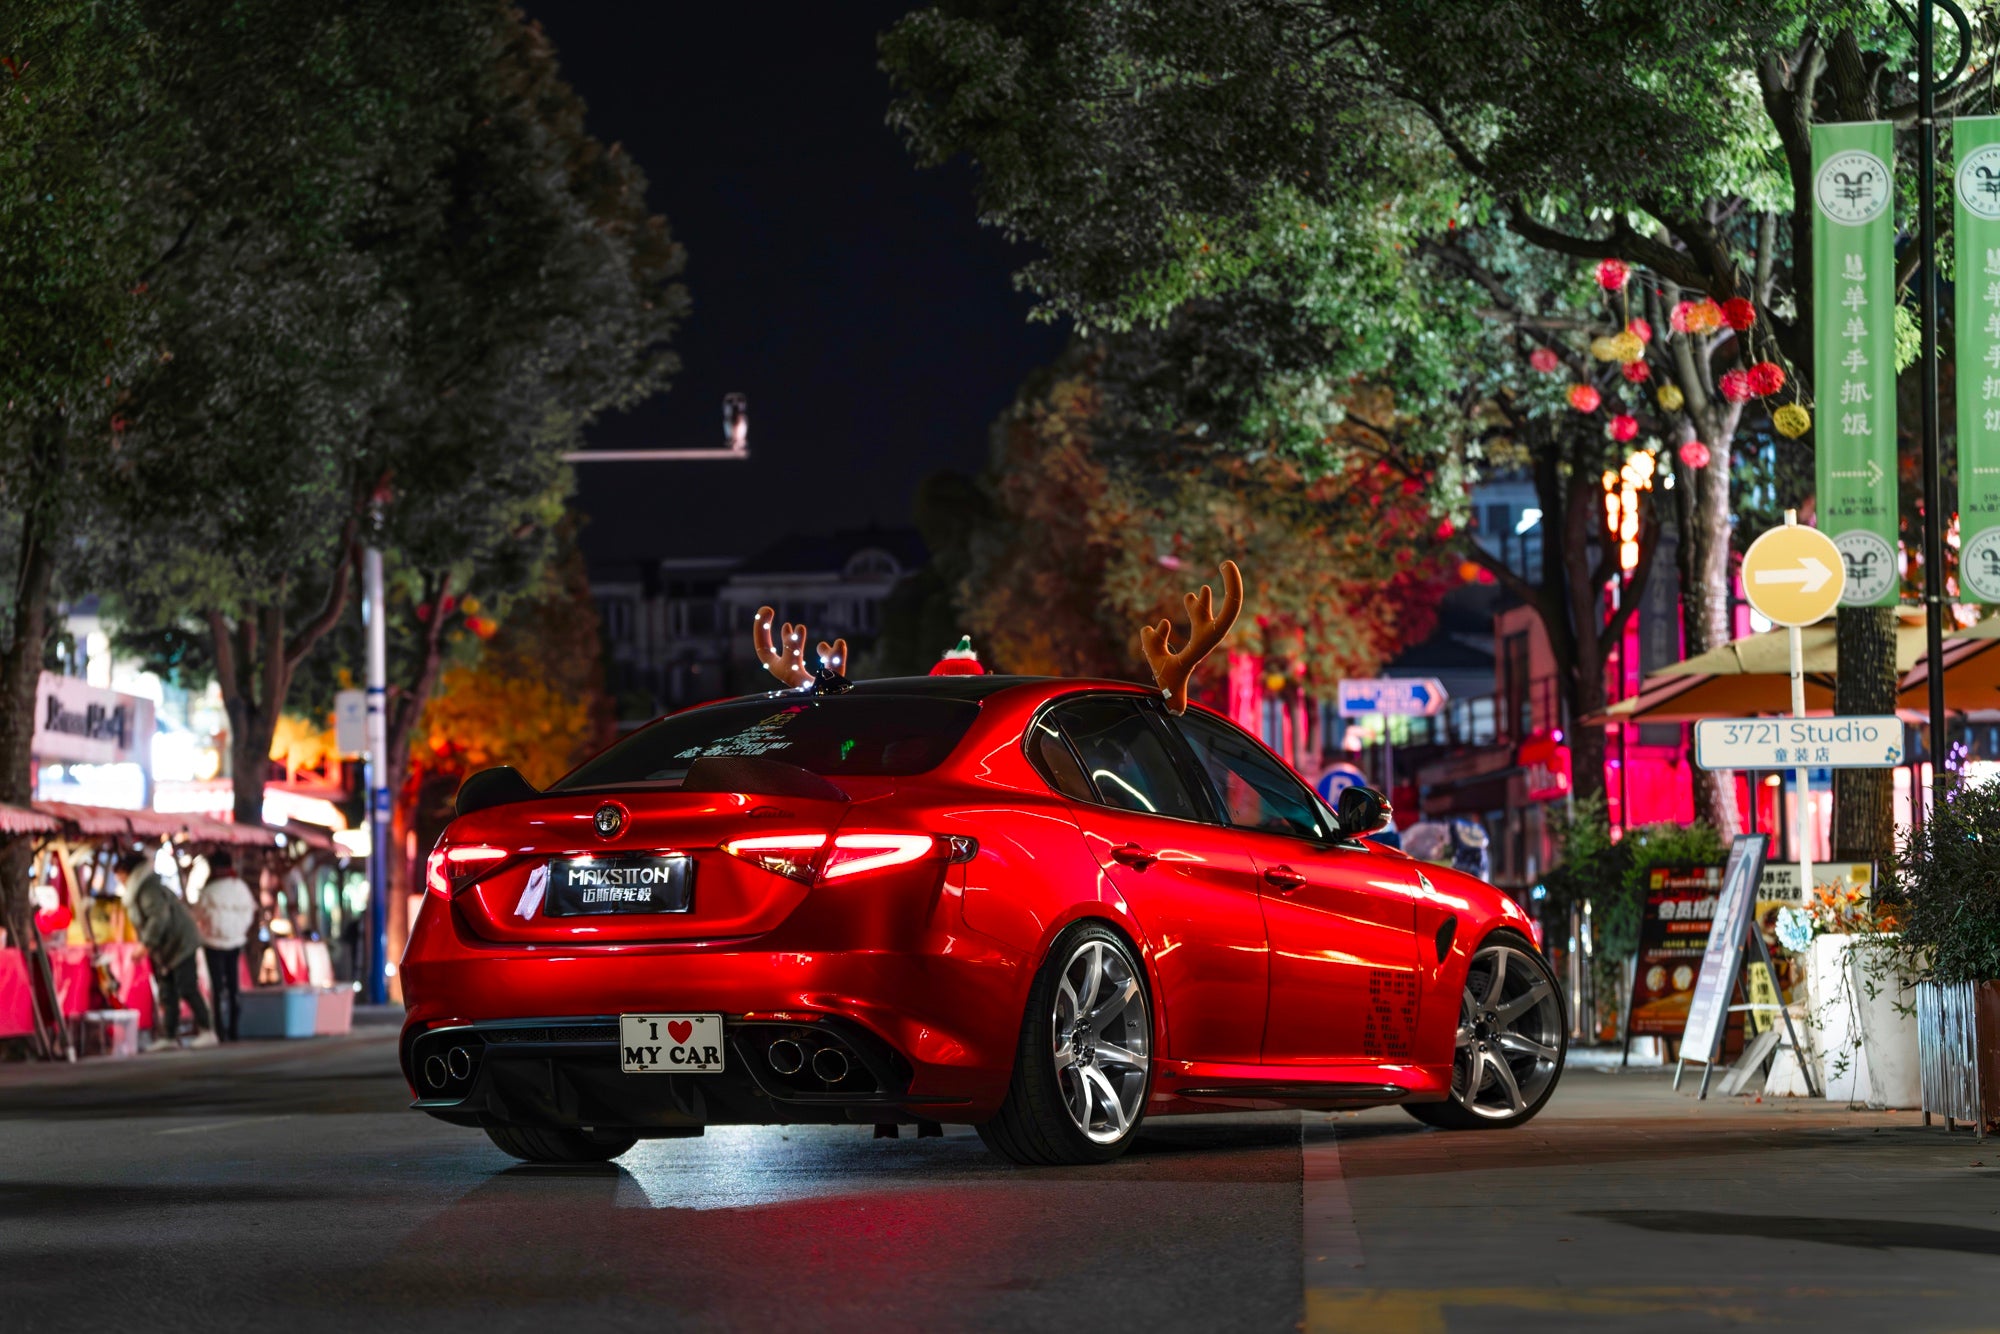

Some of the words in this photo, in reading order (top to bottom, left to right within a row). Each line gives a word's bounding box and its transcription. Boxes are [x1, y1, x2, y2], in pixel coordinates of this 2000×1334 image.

[1723, 724, 1780, 744] 3721
[1790, 721, 1879, 743] Studio
[1774, 747, 1830, 763] 童装店
[649, 1022, 659, 1041] I
[624, 1046, 662, 1065] MY
[669, 1046, 721, 1065] CAR
